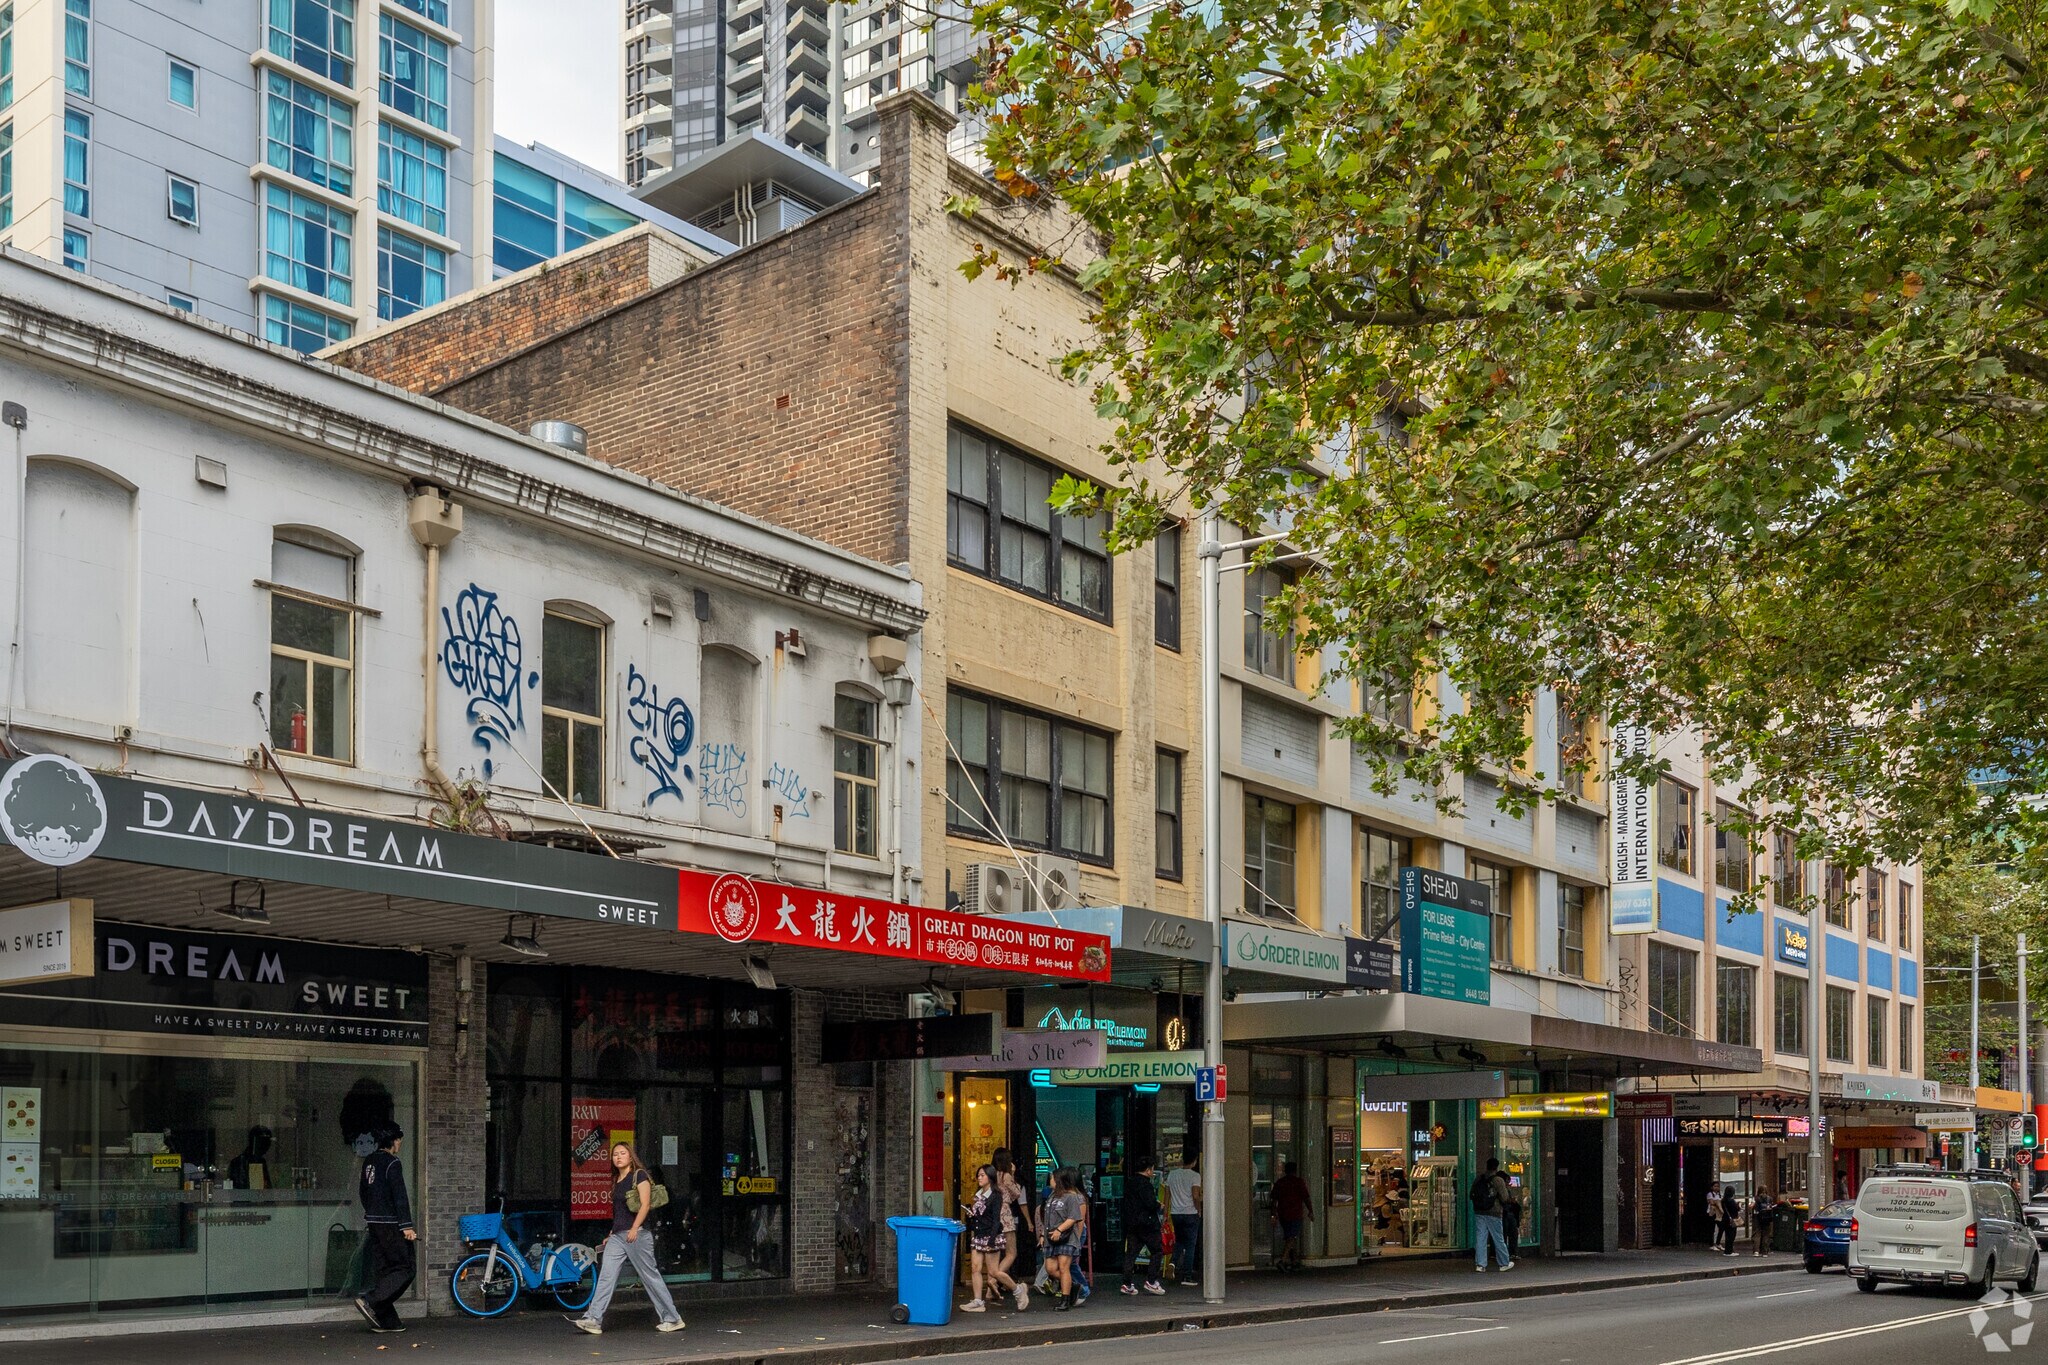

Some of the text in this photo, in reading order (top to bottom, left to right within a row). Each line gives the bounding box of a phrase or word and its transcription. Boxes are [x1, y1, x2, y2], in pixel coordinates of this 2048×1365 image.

[143, 790, 443, 869] DAYDREAM
[1617, 841, 1628, 881] ENGLISH
[1406, 871, 1415, 909] SHEAD
[1423, 874, 1459, 900] SHEAD
[598, 903, 658, 925] SWEET
[775, 893, 912, 950] 大龍火鍋
[1423, 909, 1455, 928] FOR LEASE
[14, 930, 64, 951] SWEET
[924, 917, 1075, 952] GREAT DRAGON HOT POT
[1423, 928, 1440, 942] Prime
[1440, 931, 1455, 945] Retail
[1459, 935, 1470, 950] City
[42, 964, 56, 973] SINCE
[1303, 950, 1339, 971] LEMON
[302, 981, 410, 1010] SWEET
[154, 1014, 421, 1040] HAVE A SWEET DAY HAVE A SWEET DREAM
[1116, 1026, 1147, 1040] LEMON
[1072, 1037, 1093, 1048] Fashion
[1143, 1062, 1198, 1077] LEMON
[1200, 1082, 1211, 1098] P
[572, 1105, 602, 1120] R&W
[571, 1125, 592, 1141] For
[1700, 1119, 1764, 1135] SEOULRIA
[575, 1130, 600, 1156] DEPOSIT
[581, 1140, 602, 1160] TAKEN
[155, 1157, 179, 1166] CLOSED
[571, 1190, 598, 1204] 8023
[1881, 1186, 1947, 1198] BLINDMAN
[1875, 1206, 1950, 1216] www.blindman.com.au
[1909, 1199, 1936, 1207] 2BLIND
